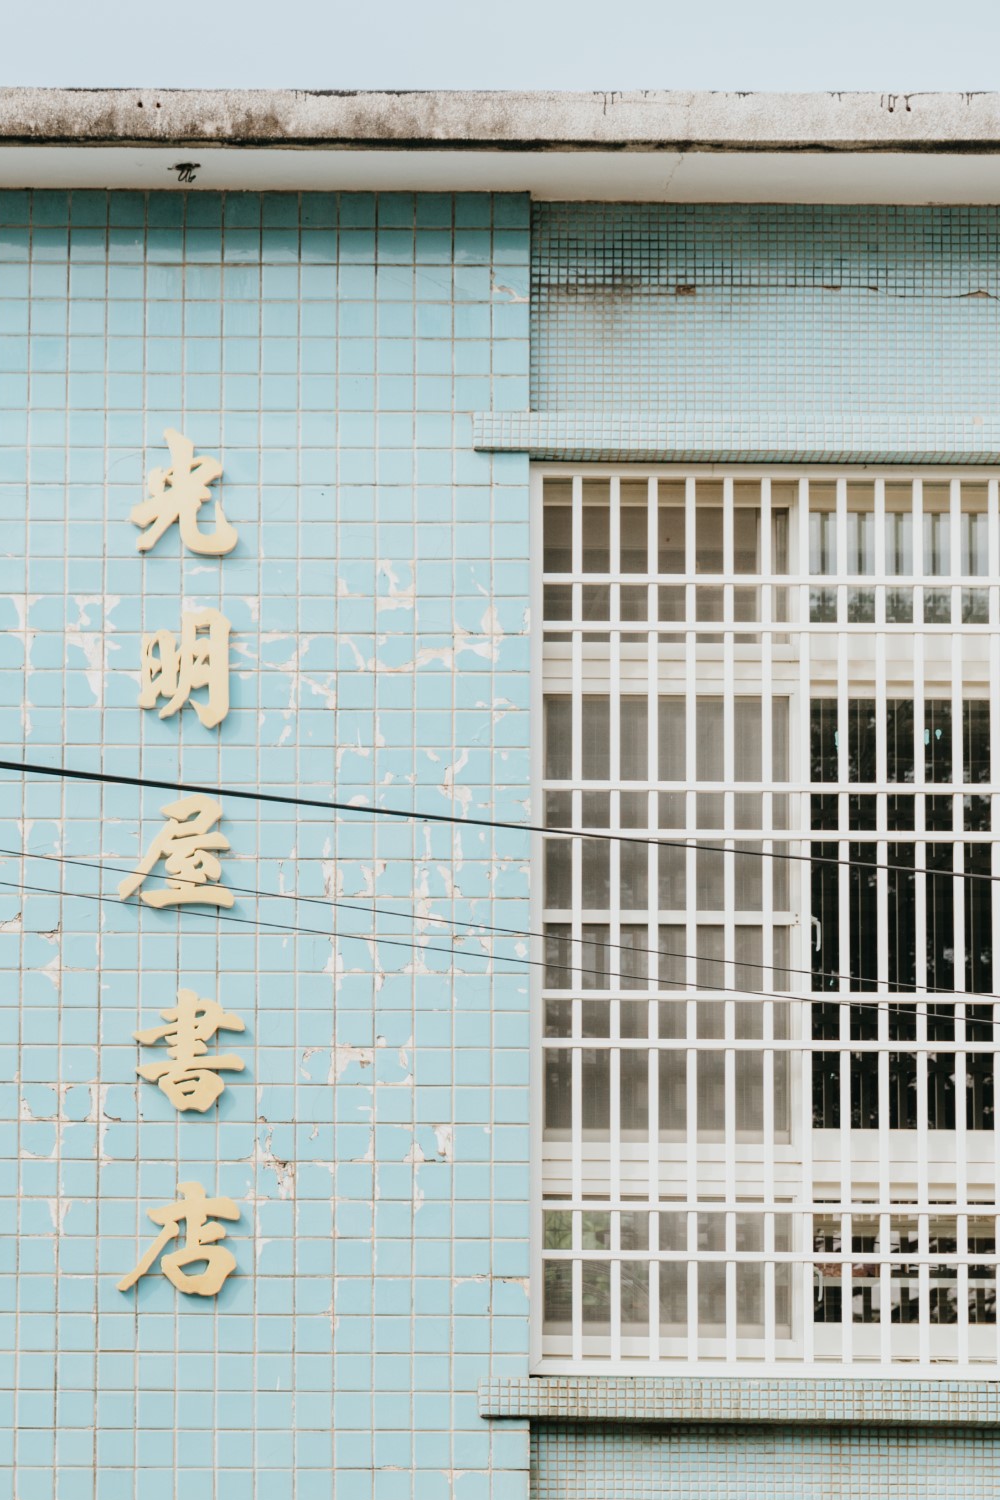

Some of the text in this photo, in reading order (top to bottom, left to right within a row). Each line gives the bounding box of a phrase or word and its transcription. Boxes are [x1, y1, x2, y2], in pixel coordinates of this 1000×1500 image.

[116, 427, 246, 1298] 光明屋書店
